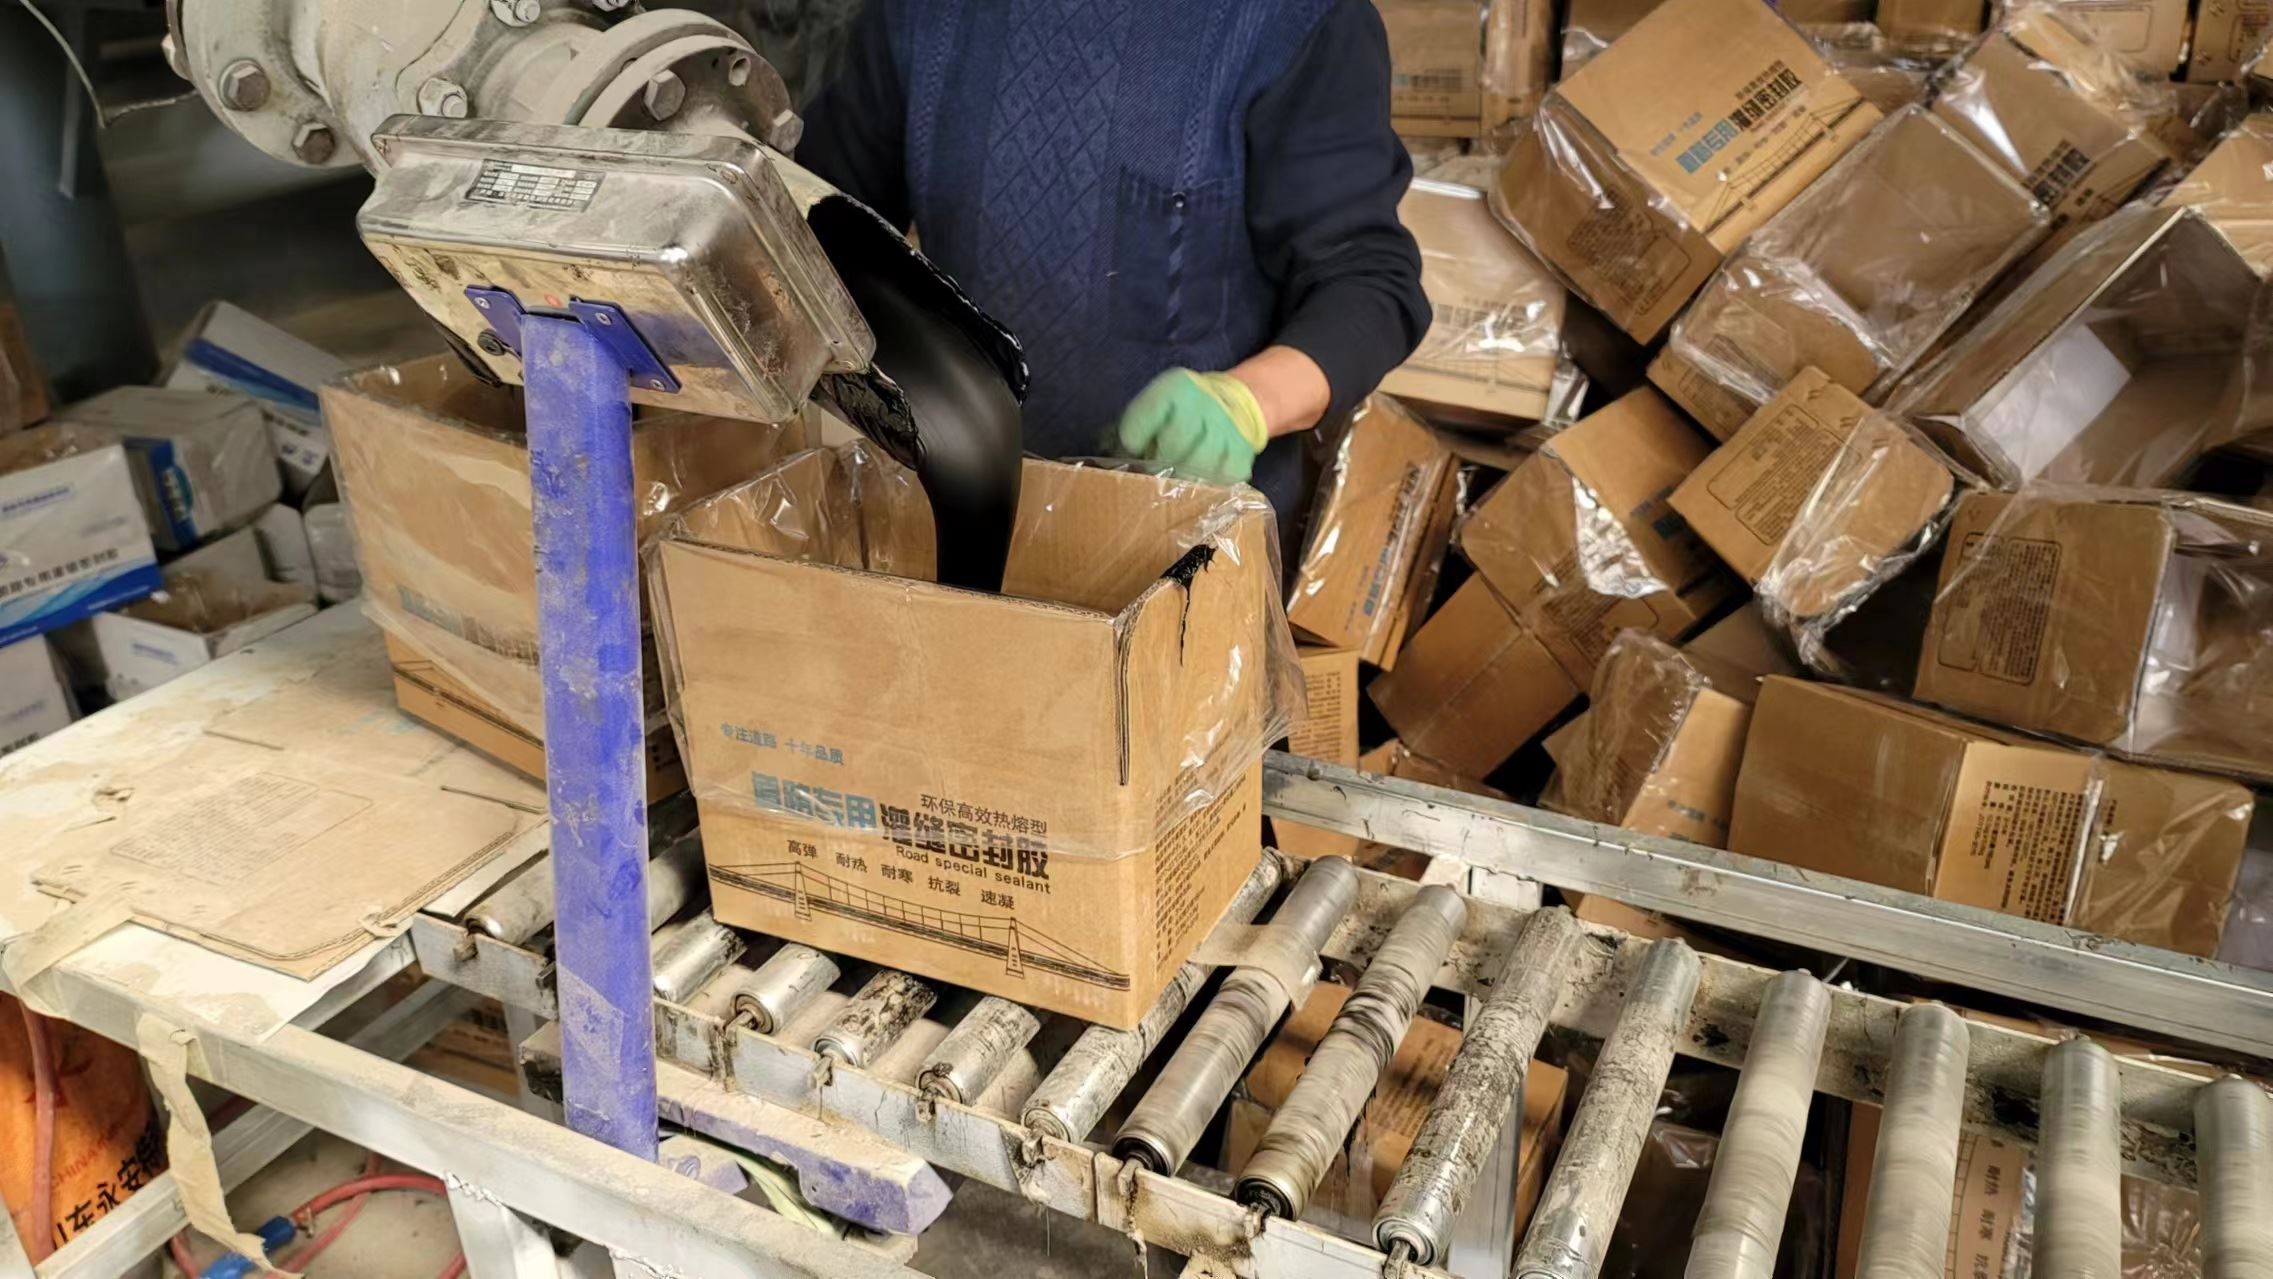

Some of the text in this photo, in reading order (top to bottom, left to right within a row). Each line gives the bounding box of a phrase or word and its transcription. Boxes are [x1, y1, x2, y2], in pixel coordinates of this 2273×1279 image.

[920, 793, 1048, 836] 环保高效热熔型
[787, 840, 1016, 911] 高弹 耐热 耐寒 抗裂 速凝
[895, 845, 1051, 895] Road special sealant
